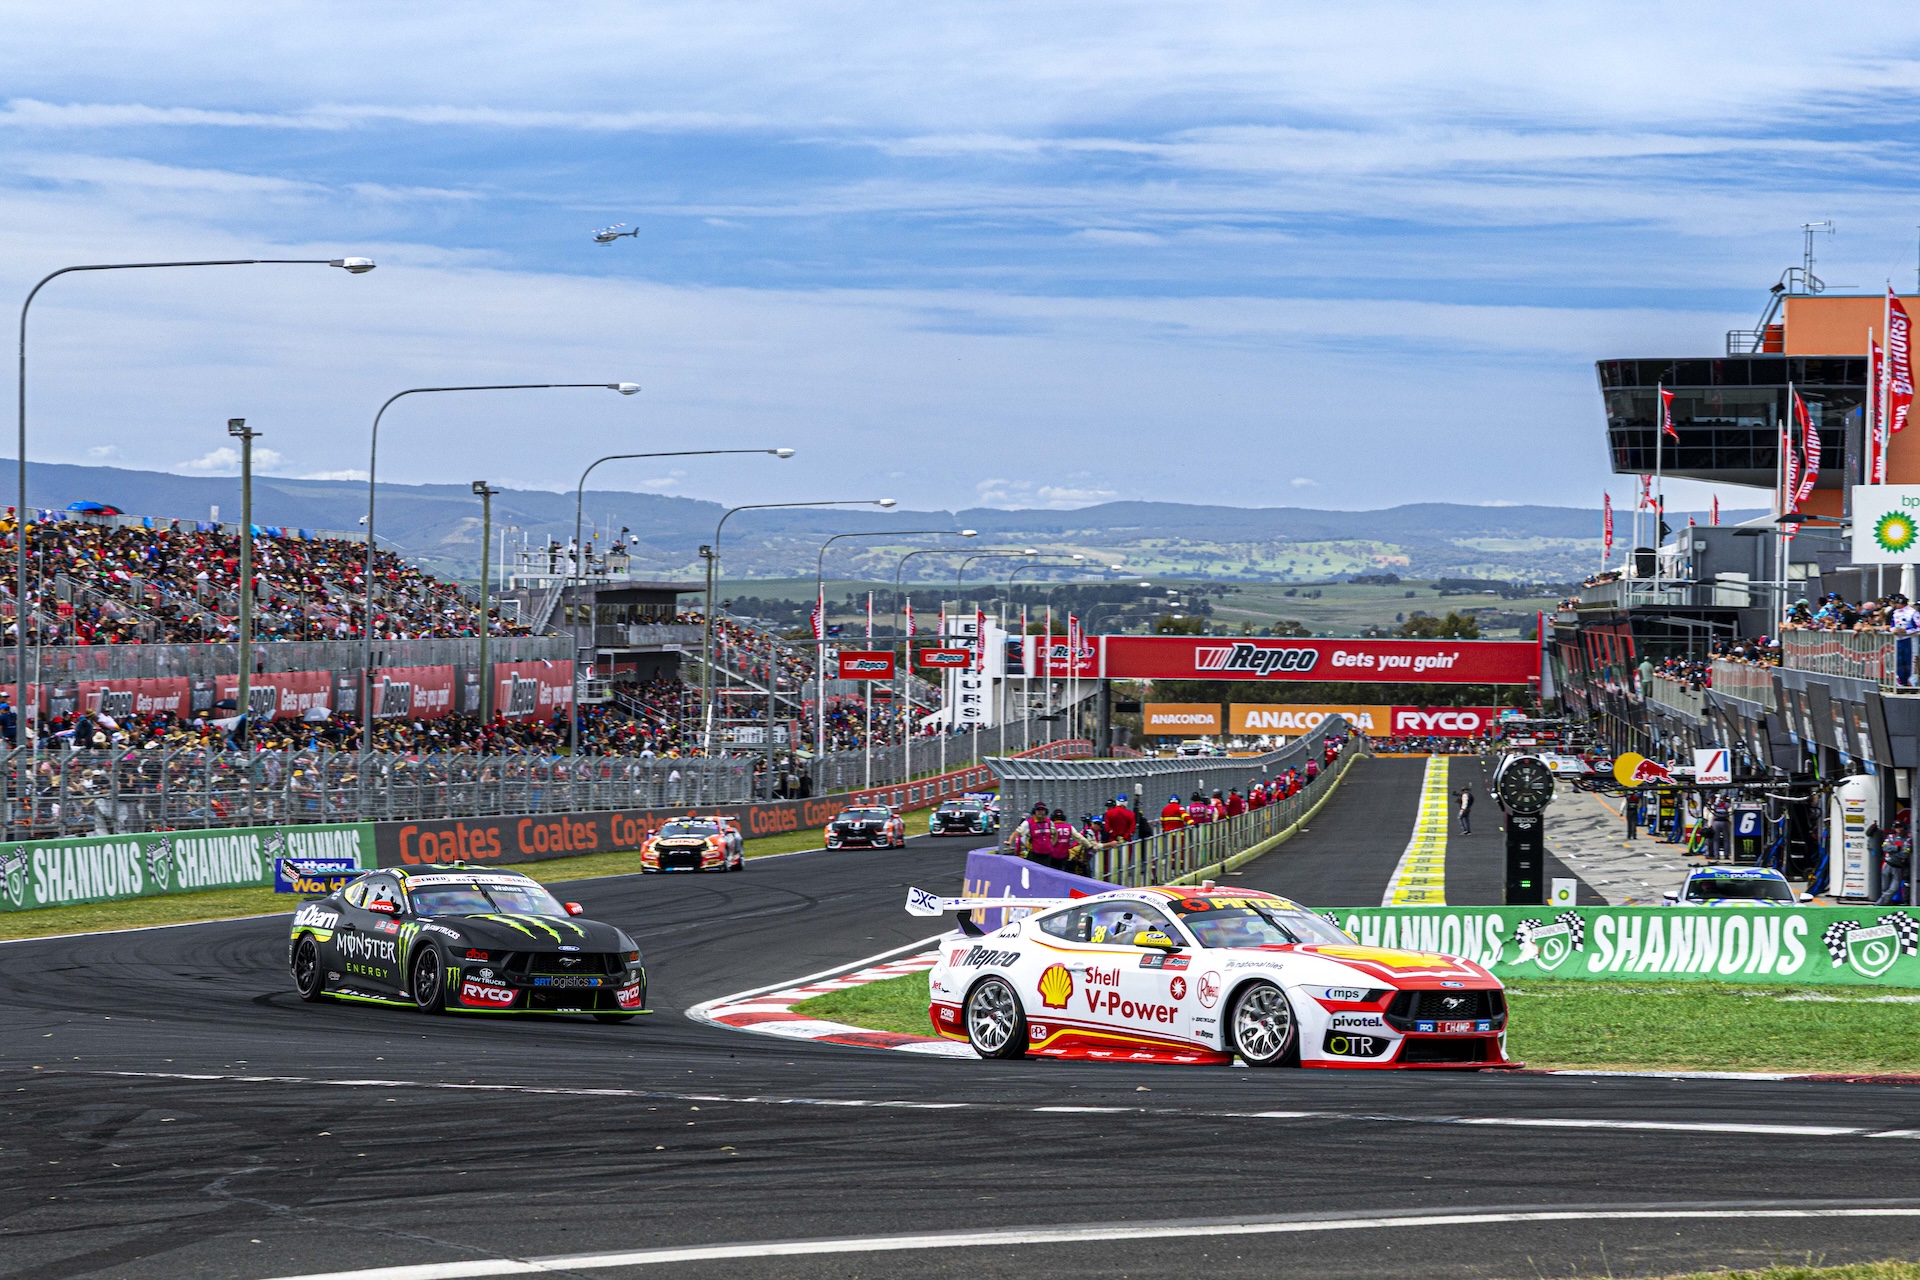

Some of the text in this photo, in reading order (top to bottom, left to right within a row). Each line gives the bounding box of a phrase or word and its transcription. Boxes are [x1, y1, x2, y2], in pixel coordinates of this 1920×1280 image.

[1902, 494, 1920, 509] bp
[857, 661, 888, 671] Repco
[935, 653, 964, 663] Repco
[1227, 643, 1319, 675] Repco
[1332, 650, 1374, 667] Gets
[1377, 655, 1412, 672] you
[1151, 714, 1215, 725] ANACONDA
[1397, 712, 1480, 730] RYCO
[750, 805, 797, 834] Coates
[1740, 812, 1757, 834] 6
[400, 822, 501, 865] Coates
[518, 816, 598, 854] Coates
[33, 840, 144, 904] SHANNONS
[176, 834, 263, 889] SHANNONS
[1091, 926, 1107, 943] 38
[1345, 913, 1505, 970] SHANNONS
[1587, 915, 1808, 975] SHANNONS
[336, 931, 397, 964] MONSTER
[466, 948, 489, 959] dba
[963, 945, 1021, 969] Repco
[346, 962, 388, 978] ENERGY
[1085, 966, 1120, 987] Shell
[482, 977, 506, 986] TRUCKS
[463, 984, 513, 1002] RYCO
[617, 986, 639, 1003] RYCO
[1334, 989, 1359, 999] mps
[1085, 988, 1178, 1024] V-Power
